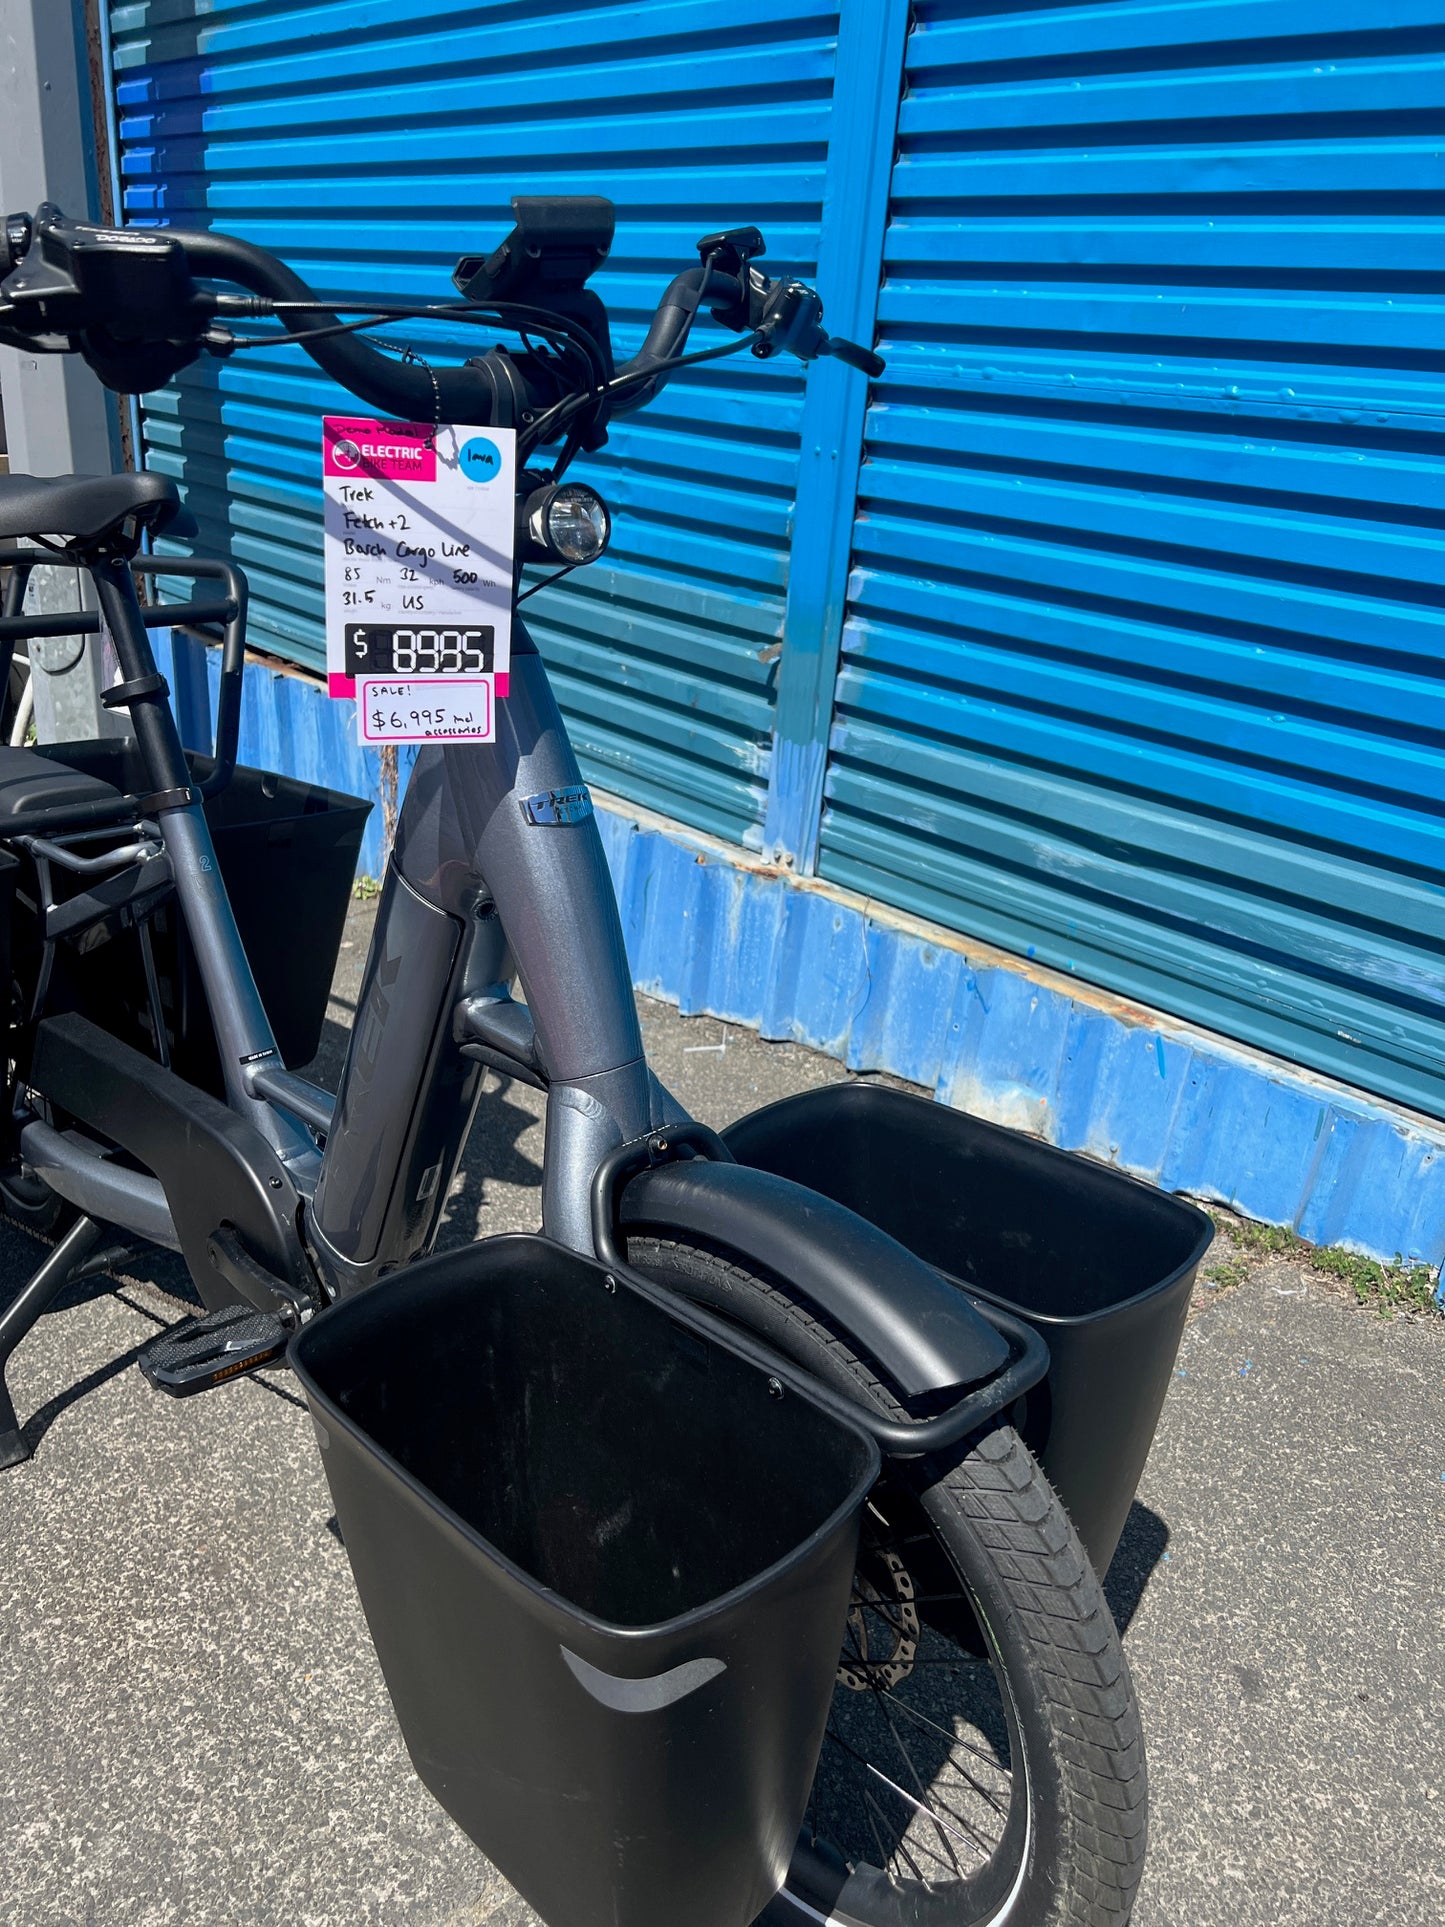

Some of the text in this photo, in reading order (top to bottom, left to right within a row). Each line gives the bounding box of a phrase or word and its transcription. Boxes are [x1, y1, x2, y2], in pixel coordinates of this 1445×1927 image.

[361, 444, 422, 460] ELECTRIC
[362, 457, 422, 471] BIKE TEAM
[339, 485, 374, 502] Trek
[343, 511, 411, 531] Fetch +2
[396, 540, 435, 568] Cargo
[441, 542, 471, 558] Line
[344, 567, 497, 588] 85 Nm 32 kph 500 Wh
[342, 589, 424, 611] 31.5 kg US
[371, 684, 412, 697] SALE!
[198, 855, 212, 872] 2
